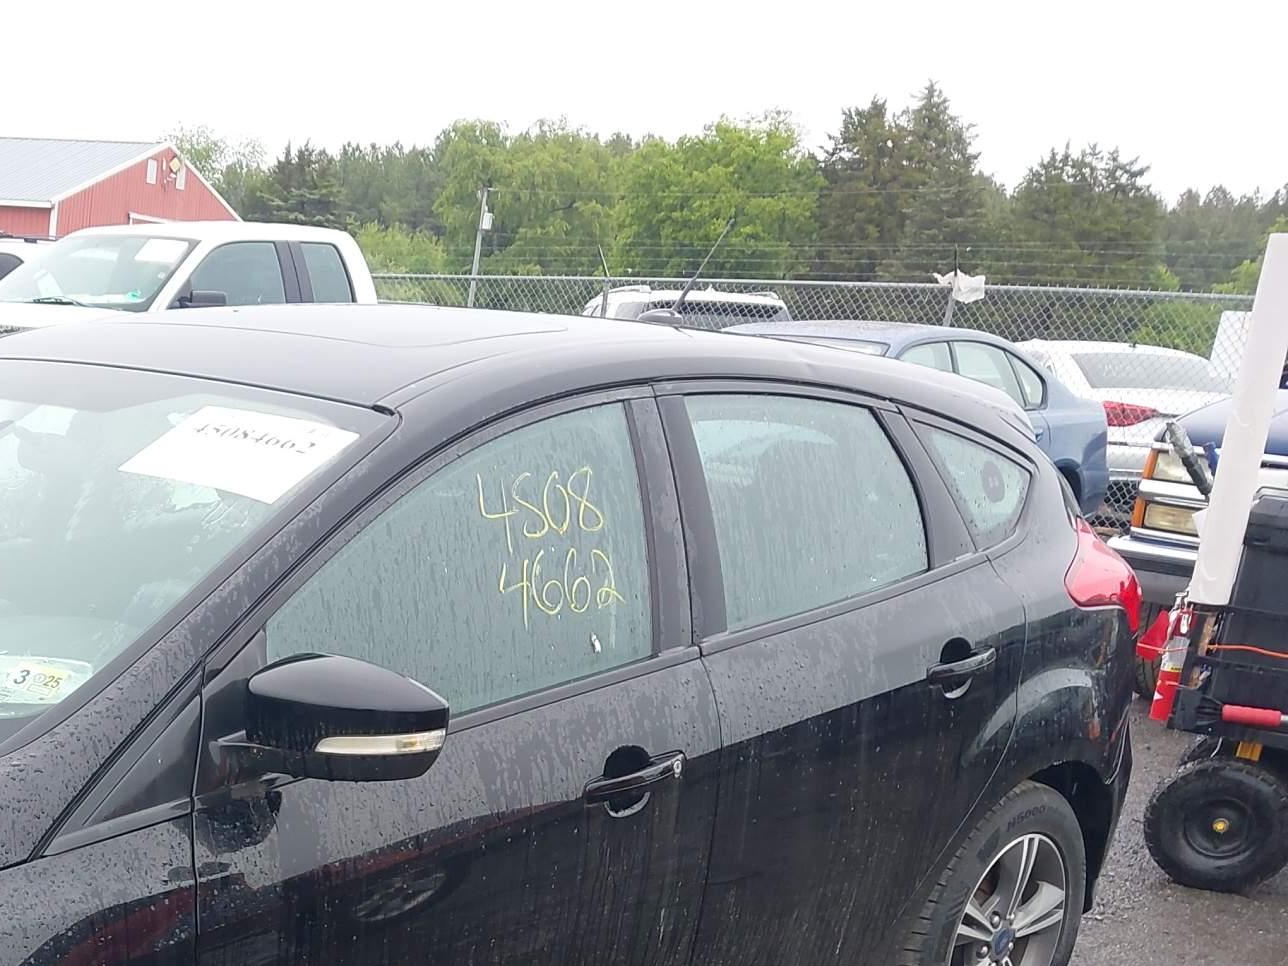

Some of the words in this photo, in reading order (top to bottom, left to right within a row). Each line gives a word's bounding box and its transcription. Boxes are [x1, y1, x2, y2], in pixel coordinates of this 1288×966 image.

[476, 466, 605, 555] 4508
[499, 548, 625, 630] 4662
[13, 669, 31, 685] 3
[42, 675, 63, 689] 25
